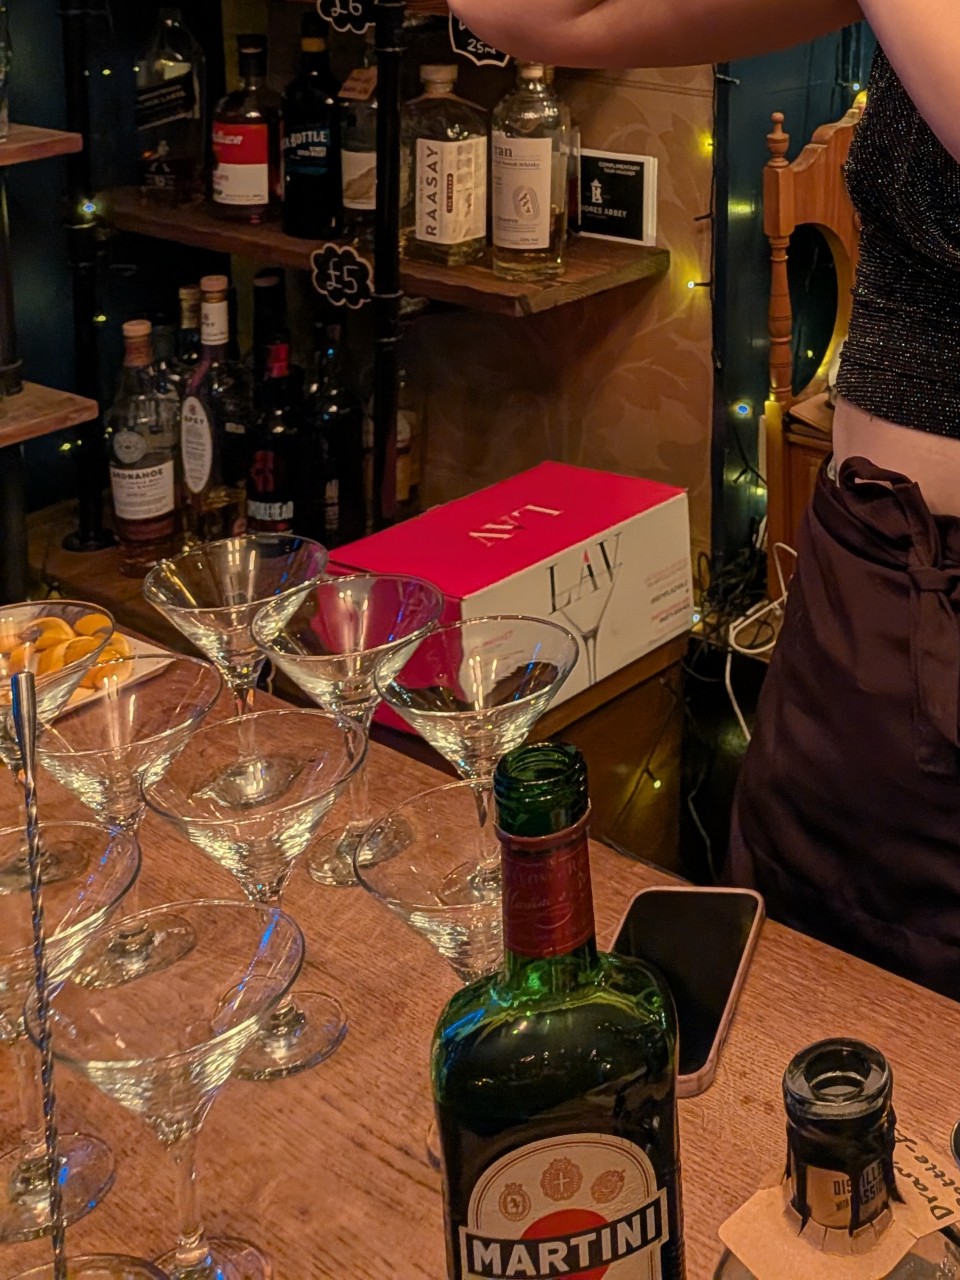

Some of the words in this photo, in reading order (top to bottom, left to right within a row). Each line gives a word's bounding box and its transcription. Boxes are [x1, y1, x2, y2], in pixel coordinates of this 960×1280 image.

[425, 145, 439, 237] RAASAY
[325, 257, 360, 294] £5
[546, 530, 624, 616] LAV
[471, 1204, 657, 1278] MARTINI
